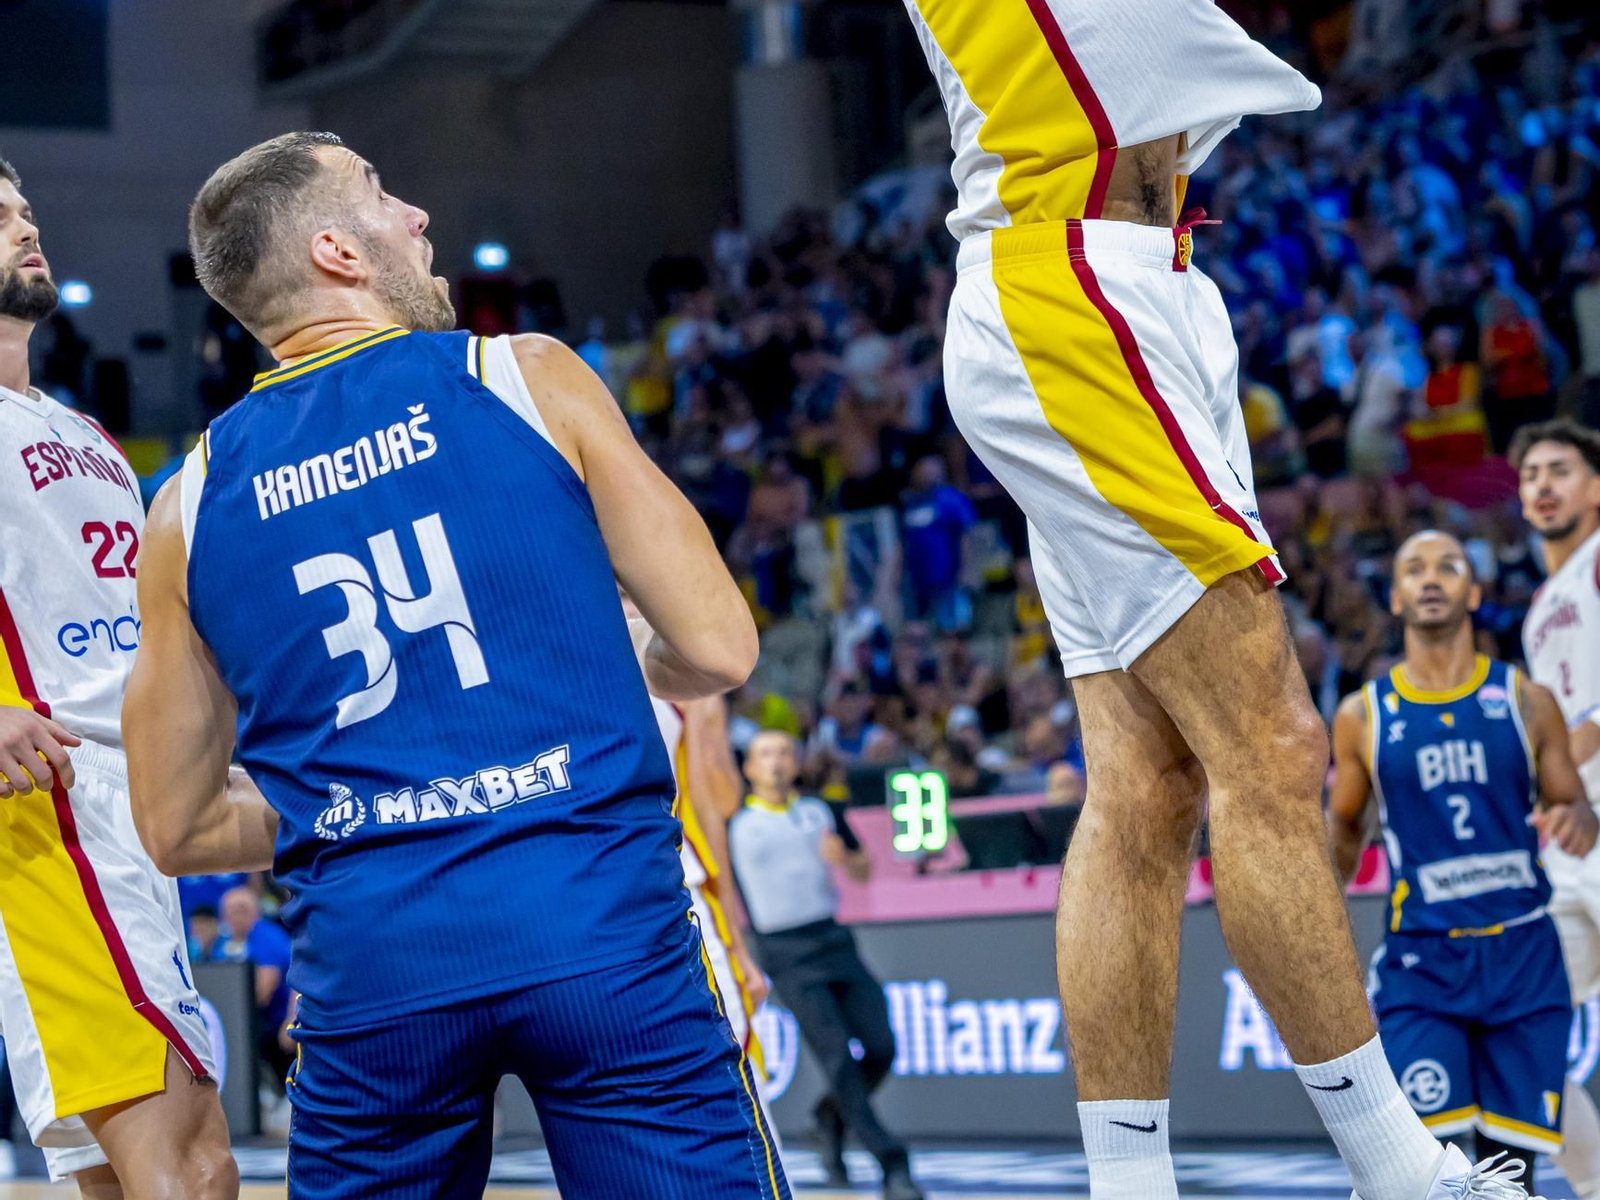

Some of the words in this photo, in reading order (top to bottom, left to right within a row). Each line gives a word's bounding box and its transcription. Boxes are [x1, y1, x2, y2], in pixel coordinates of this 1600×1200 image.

[20, 441, 139, 505] ESPAÑA
[252, 403, 438, 520] KAMENJAŠ
[81, 520, 139, 579] 22
[57, 605, 141, 657] end
[291, 512, 490, 729] 34
[373, 744, 571, 825] MAXBET
[1416, 739, 1488, 791] BIH
[890, 770, 949, 852] 33
[1446, 794, 1475, 840] 2
[884, 978, 1065, 1075] llianz
